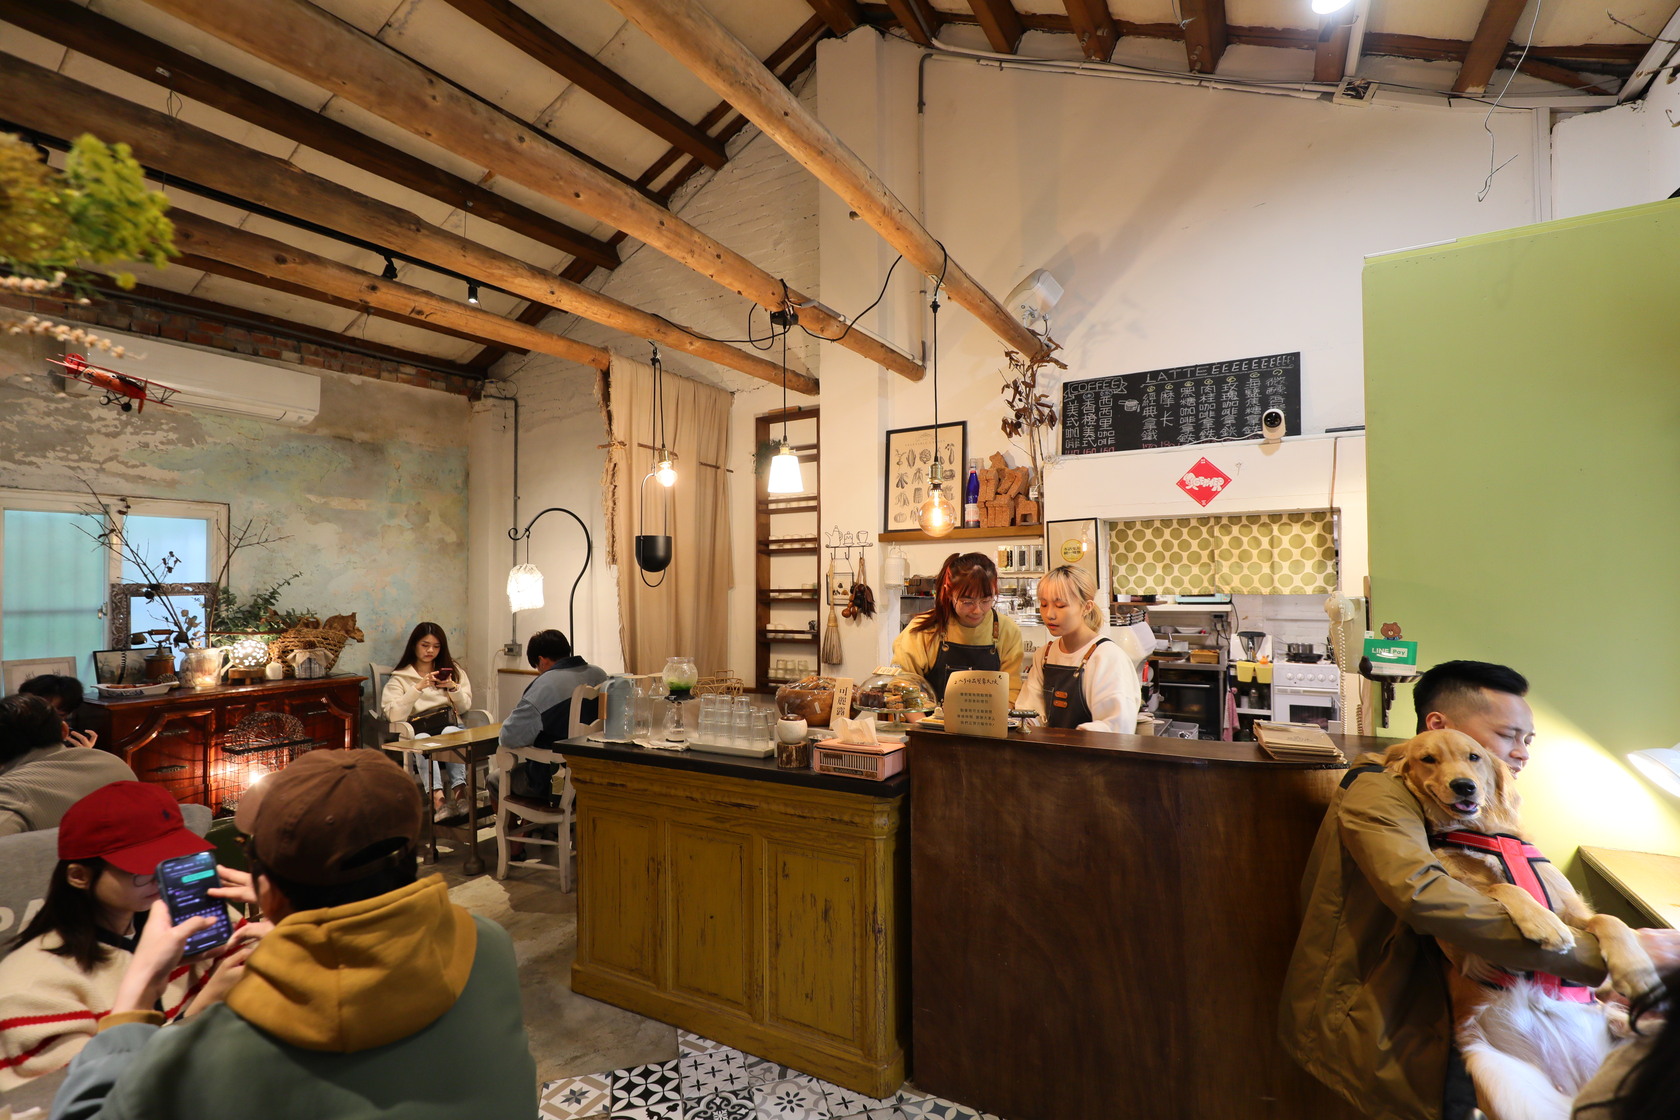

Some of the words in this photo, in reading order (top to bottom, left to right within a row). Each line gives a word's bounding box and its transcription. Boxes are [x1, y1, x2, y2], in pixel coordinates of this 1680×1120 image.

[1071, 378, 1120, 394] COFFEE
[1065, 400, 1081, 449] 美式咖啡
[1081, 398, 1098, 447] 香橙美式
[1097, 395, 1116, 446] 西西里咖啡
[1140, 392, 1158, 441] 經典拿鐵
[1392, 648, 1406, 656] Pay
